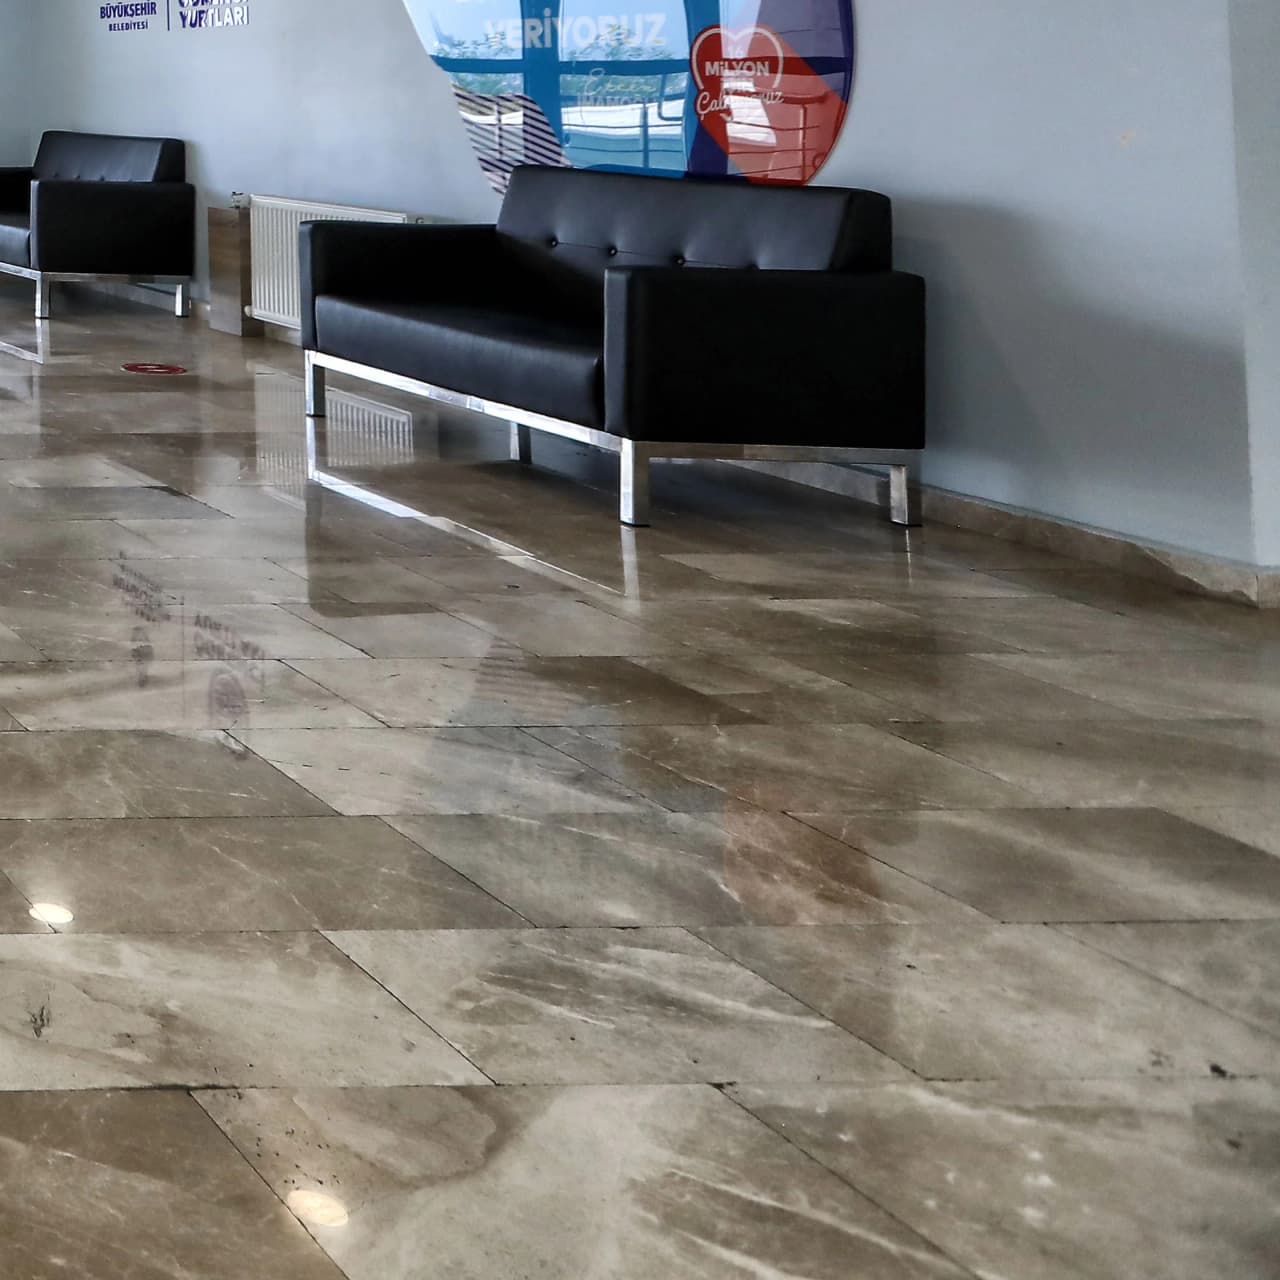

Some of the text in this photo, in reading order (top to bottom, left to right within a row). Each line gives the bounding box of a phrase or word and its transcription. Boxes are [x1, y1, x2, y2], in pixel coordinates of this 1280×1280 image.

[100, 0, 157, 20] BÜYÜKŞEHİR
[179, 5, 250, 29] YURTLARI
[109, 18, 149, 32] BELEDİYESİ
